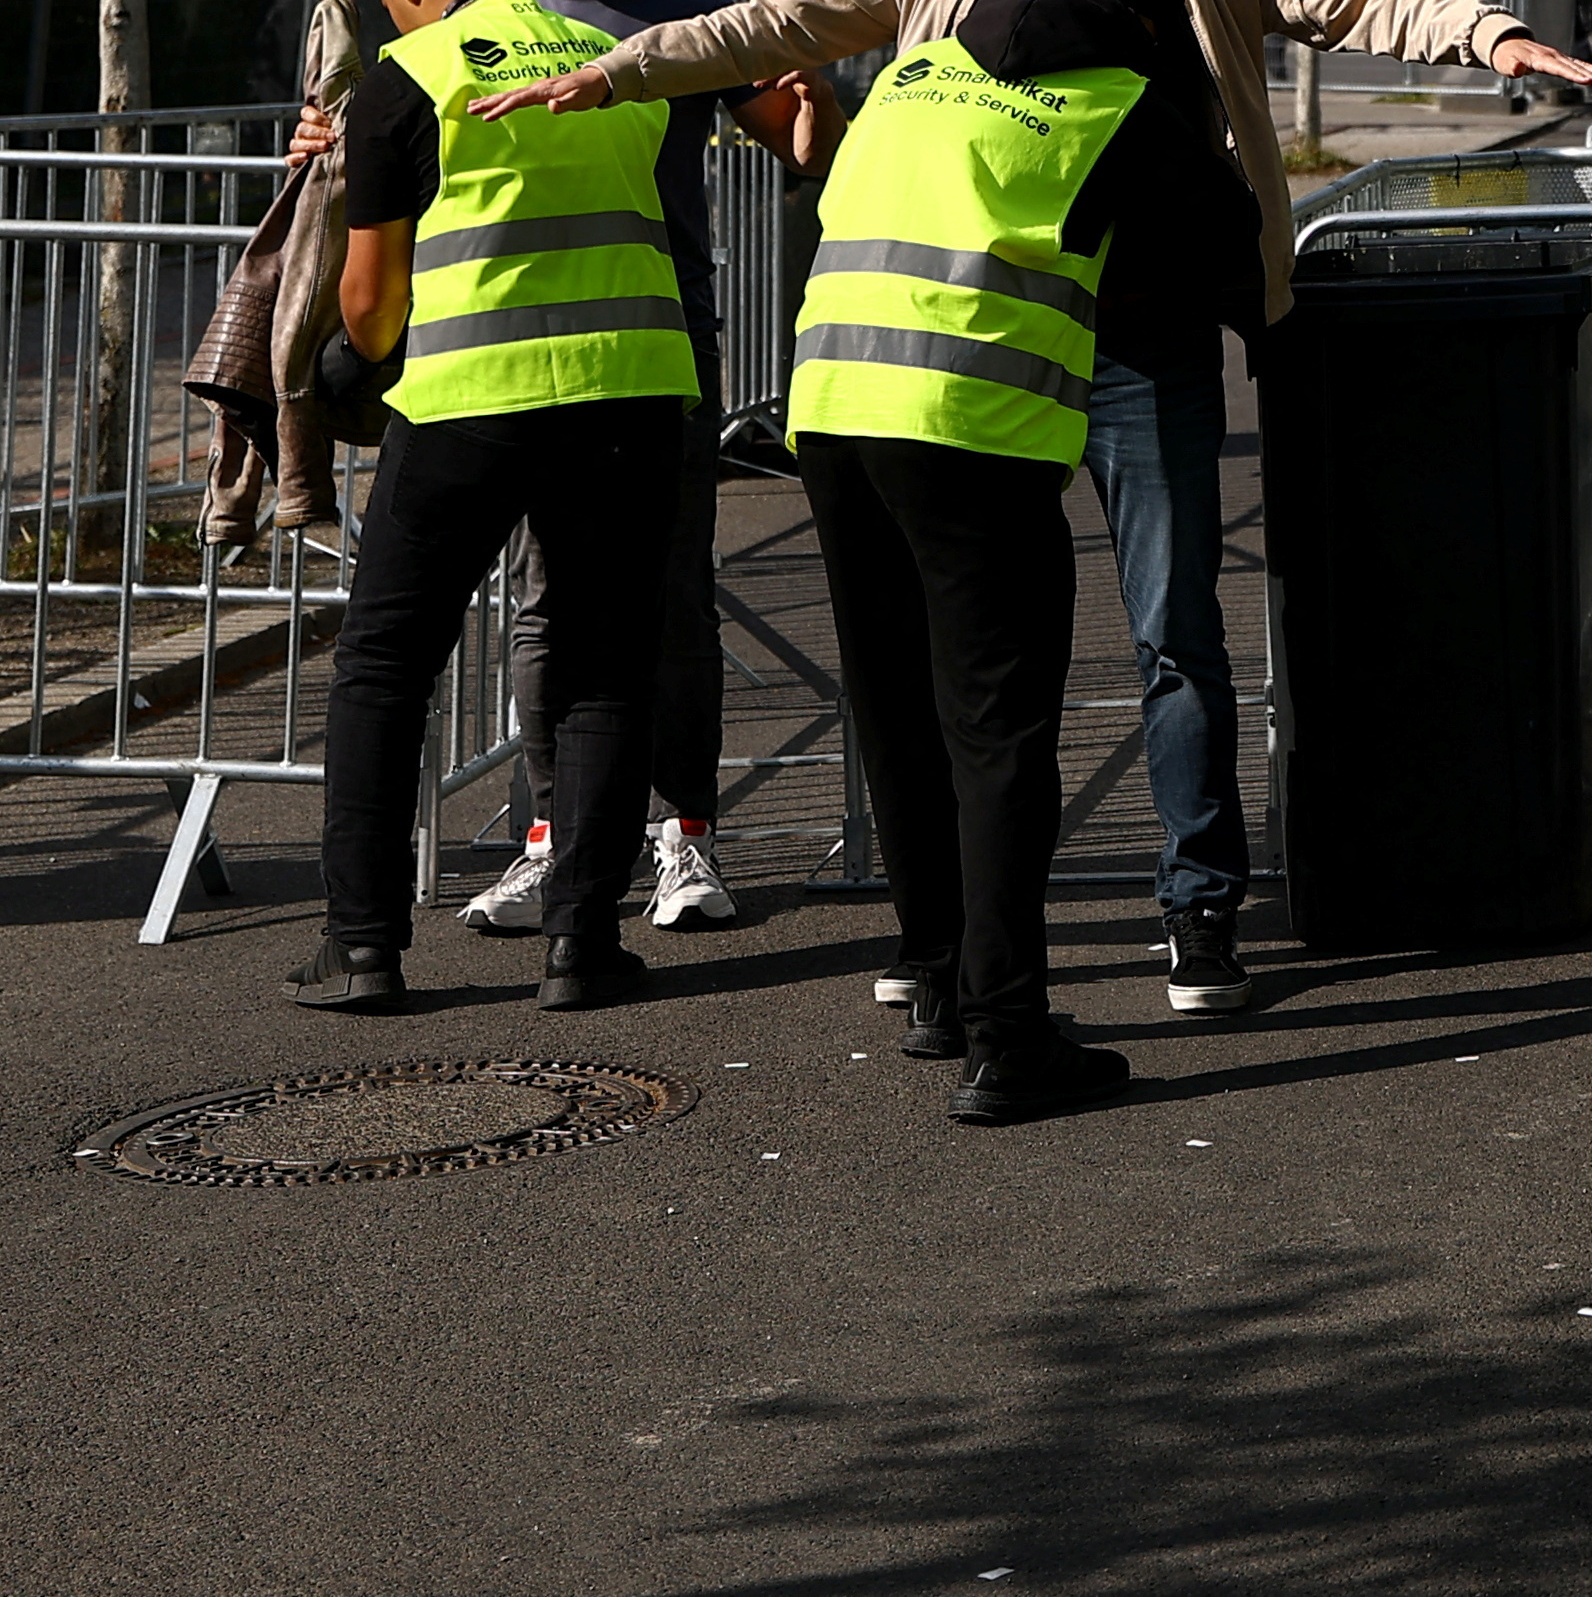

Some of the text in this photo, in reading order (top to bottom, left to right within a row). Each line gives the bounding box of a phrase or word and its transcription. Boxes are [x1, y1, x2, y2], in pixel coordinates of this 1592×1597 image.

[512, 37, 613, 56] Smartifik
[472, 64, 551, 83] Security
[557, 62, 571, 76] &
[879, 88, 1051, 137] Security & Service
